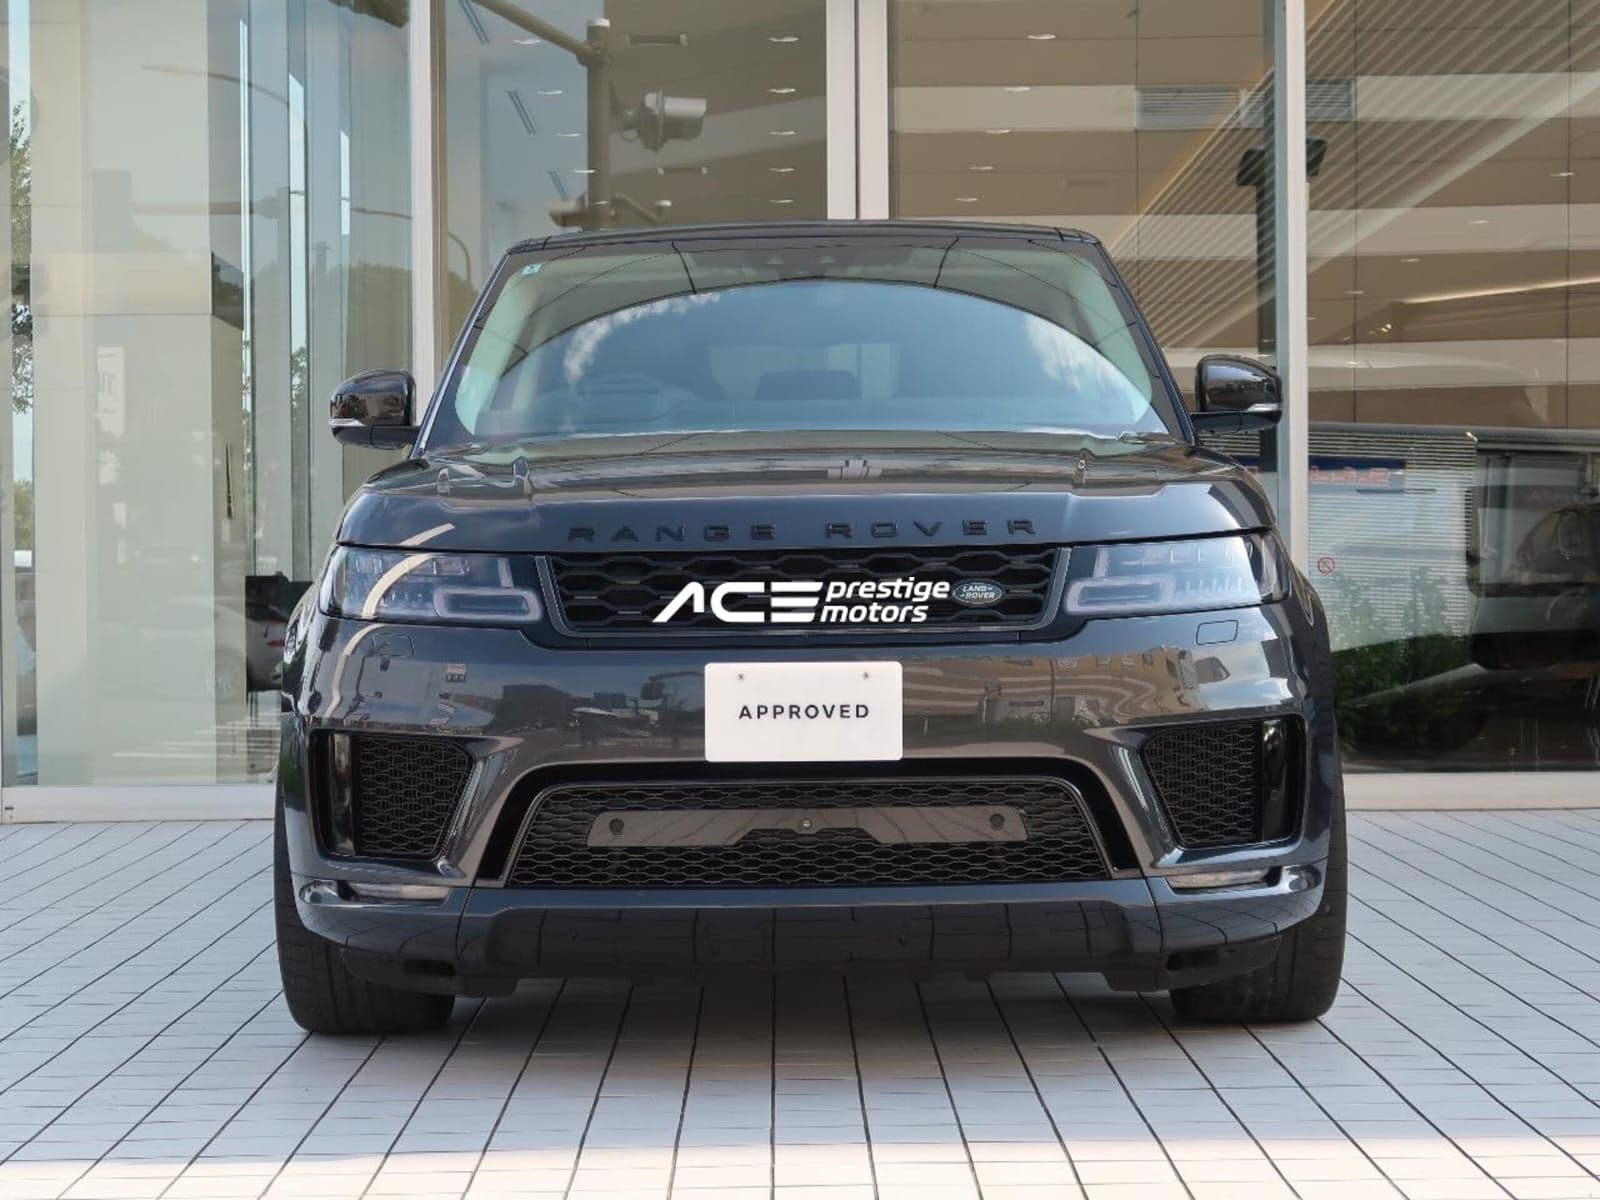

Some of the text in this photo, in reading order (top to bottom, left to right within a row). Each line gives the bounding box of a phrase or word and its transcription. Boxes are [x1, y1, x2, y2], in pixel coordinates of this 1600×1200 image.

[568, 519, 1036, 543] RANGE ROVER
[739, 704, 869, 719] APPROVED
